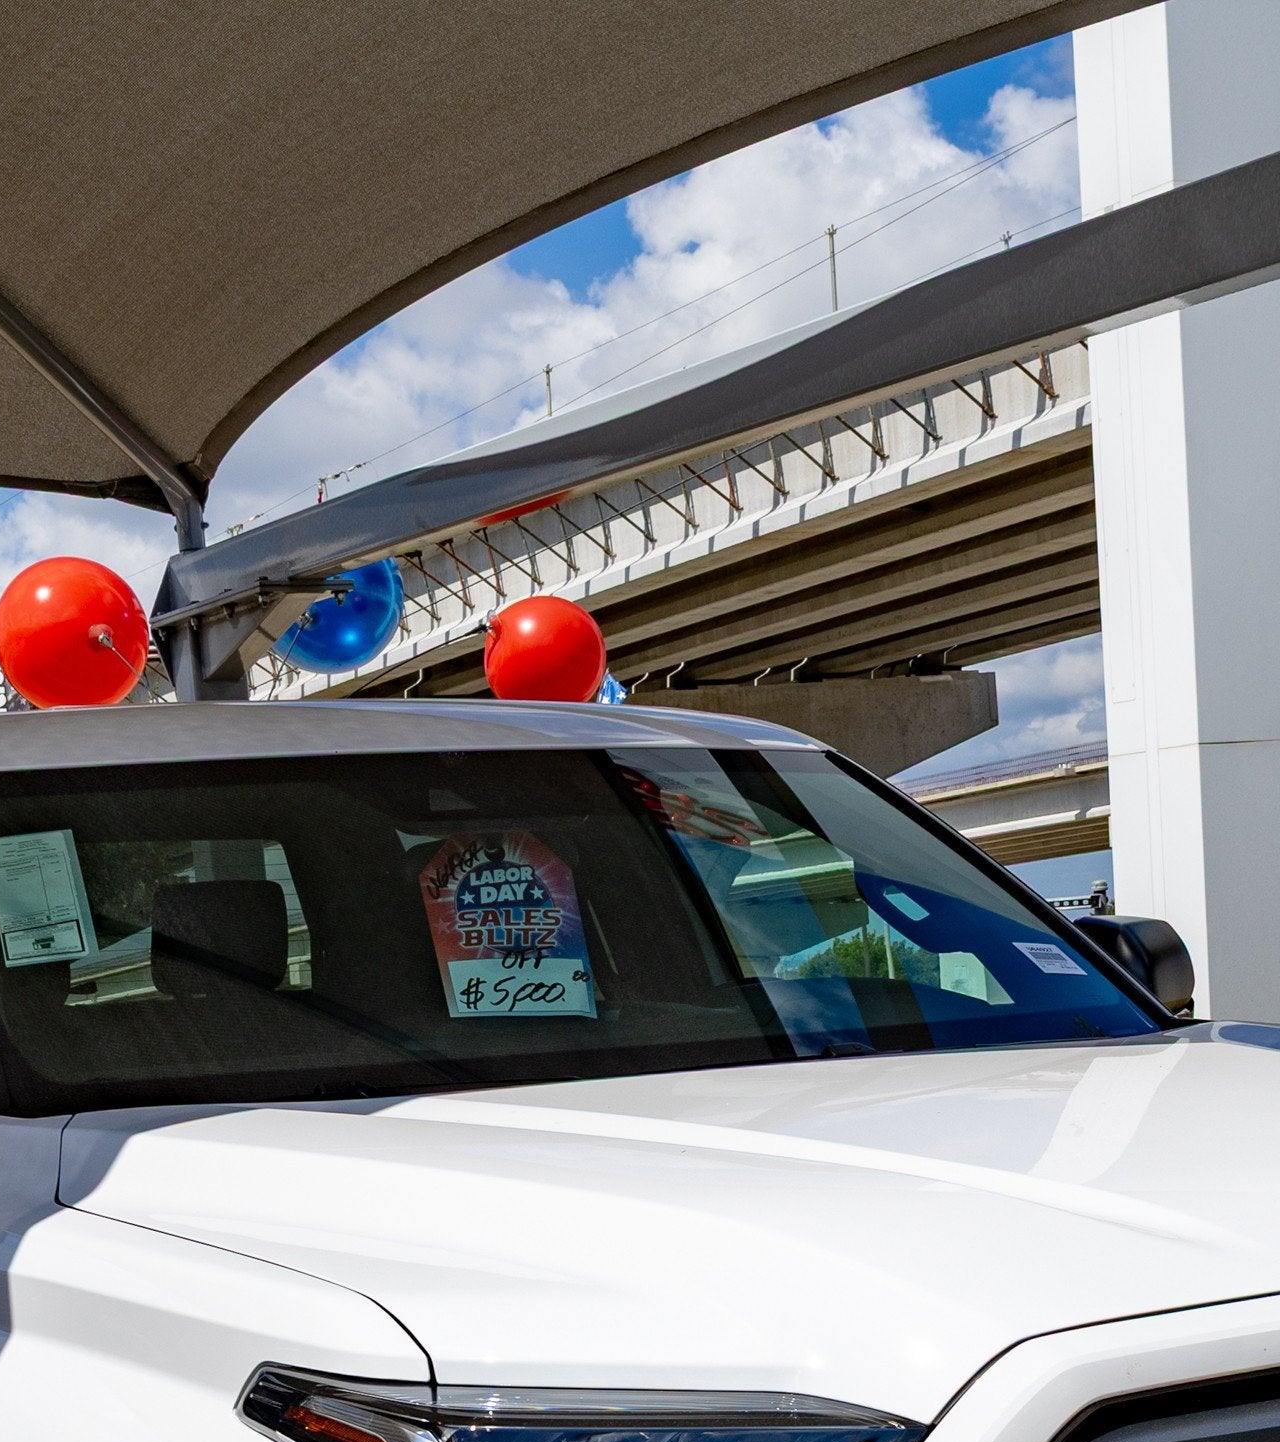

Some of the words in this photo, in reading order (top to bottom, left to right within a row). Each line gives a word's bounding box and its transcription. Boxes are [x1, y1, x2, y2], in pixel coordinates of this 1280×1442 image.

[470, 866, 534, 886] LABOR
[480, 883, 528, 904] DAY
[457, 908, 561, 928] SALES
[462, 928, 557, 947] BLITZ
